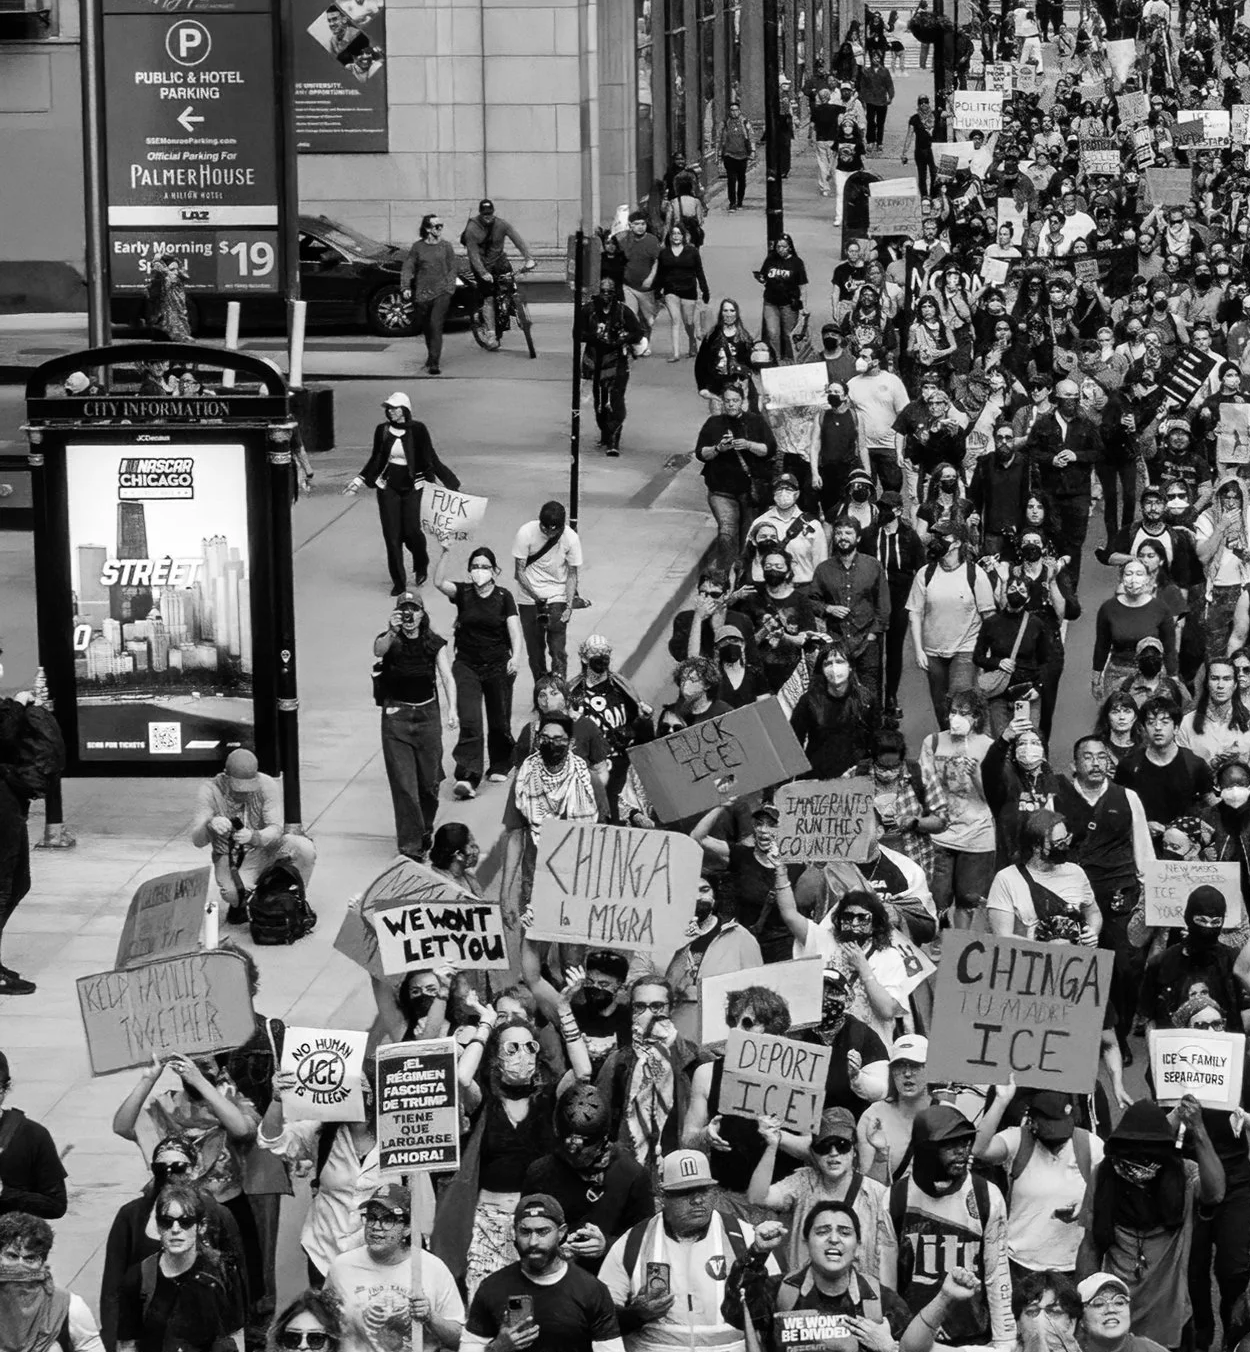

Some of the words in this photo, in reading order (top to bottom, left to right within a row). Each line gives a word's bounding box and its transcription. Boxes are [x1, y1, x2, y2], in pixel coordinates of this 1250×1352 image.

[135, 71, 184, 84] PUBLIC
[187, 71, 198, 83] &
[200, 71, 244, 83] HOTEL
[160, 87, 220, 99] PARKING
[147, 151, 180, 161] Official
[183, 151, 218, 163] Parking
[220, 151, 237, 160] For
[84, 401, 118, 417] CITY
[123, 401, 230, 417] INFORMATION
[138, 460, 193, 474] NASCAR
[120, 473, 192, 487] CHICAGO
[431, 489, 471, 519] FUCK
[433, 512, 454, 531] ICE
[100, 559, 203, 586] STREET
[665, 720, 737, 764] FUCK
[786, 794, 874, 817] IMMIGRANTS
[795, 816, 824, 835] RUN
[825, 817, 865, 835] THIS
[779, 835, 858, 858] COUNTRY
[545, 826, 672, 905] CHINGA
[382, 906, 426, 938] WE
[425, 905, 494, 933] WONT
[402, 933, 451, 964] LET
[450, 933, 506, 962] YOU
[956, 940, 1101, 1007] CHINGA
[965, 1022, 1071, 1074] ICE
[738, 1038, 825, 1083] DEPORT
[386, 1067, 446, 1085] RÉGIMEN
[1164, 1071, 1225, 1086] SEPARATORS
[383, 1081, 446, 1098] FASCISTA
[383, 1097, 400, 1111] DE
[400, 1094, 449, 1110] TRUMP
[392, 1112, 434, 1125] TIENE
[400, 1123, 430, 1135] QUE
[381, 1133, 452, 1149] LARGARSE
[386, 1150, 445, 1166] AHORA!
[781, 1330, 799, 1342] BE
[800, 1327, 851, 1340] DIVIDED
